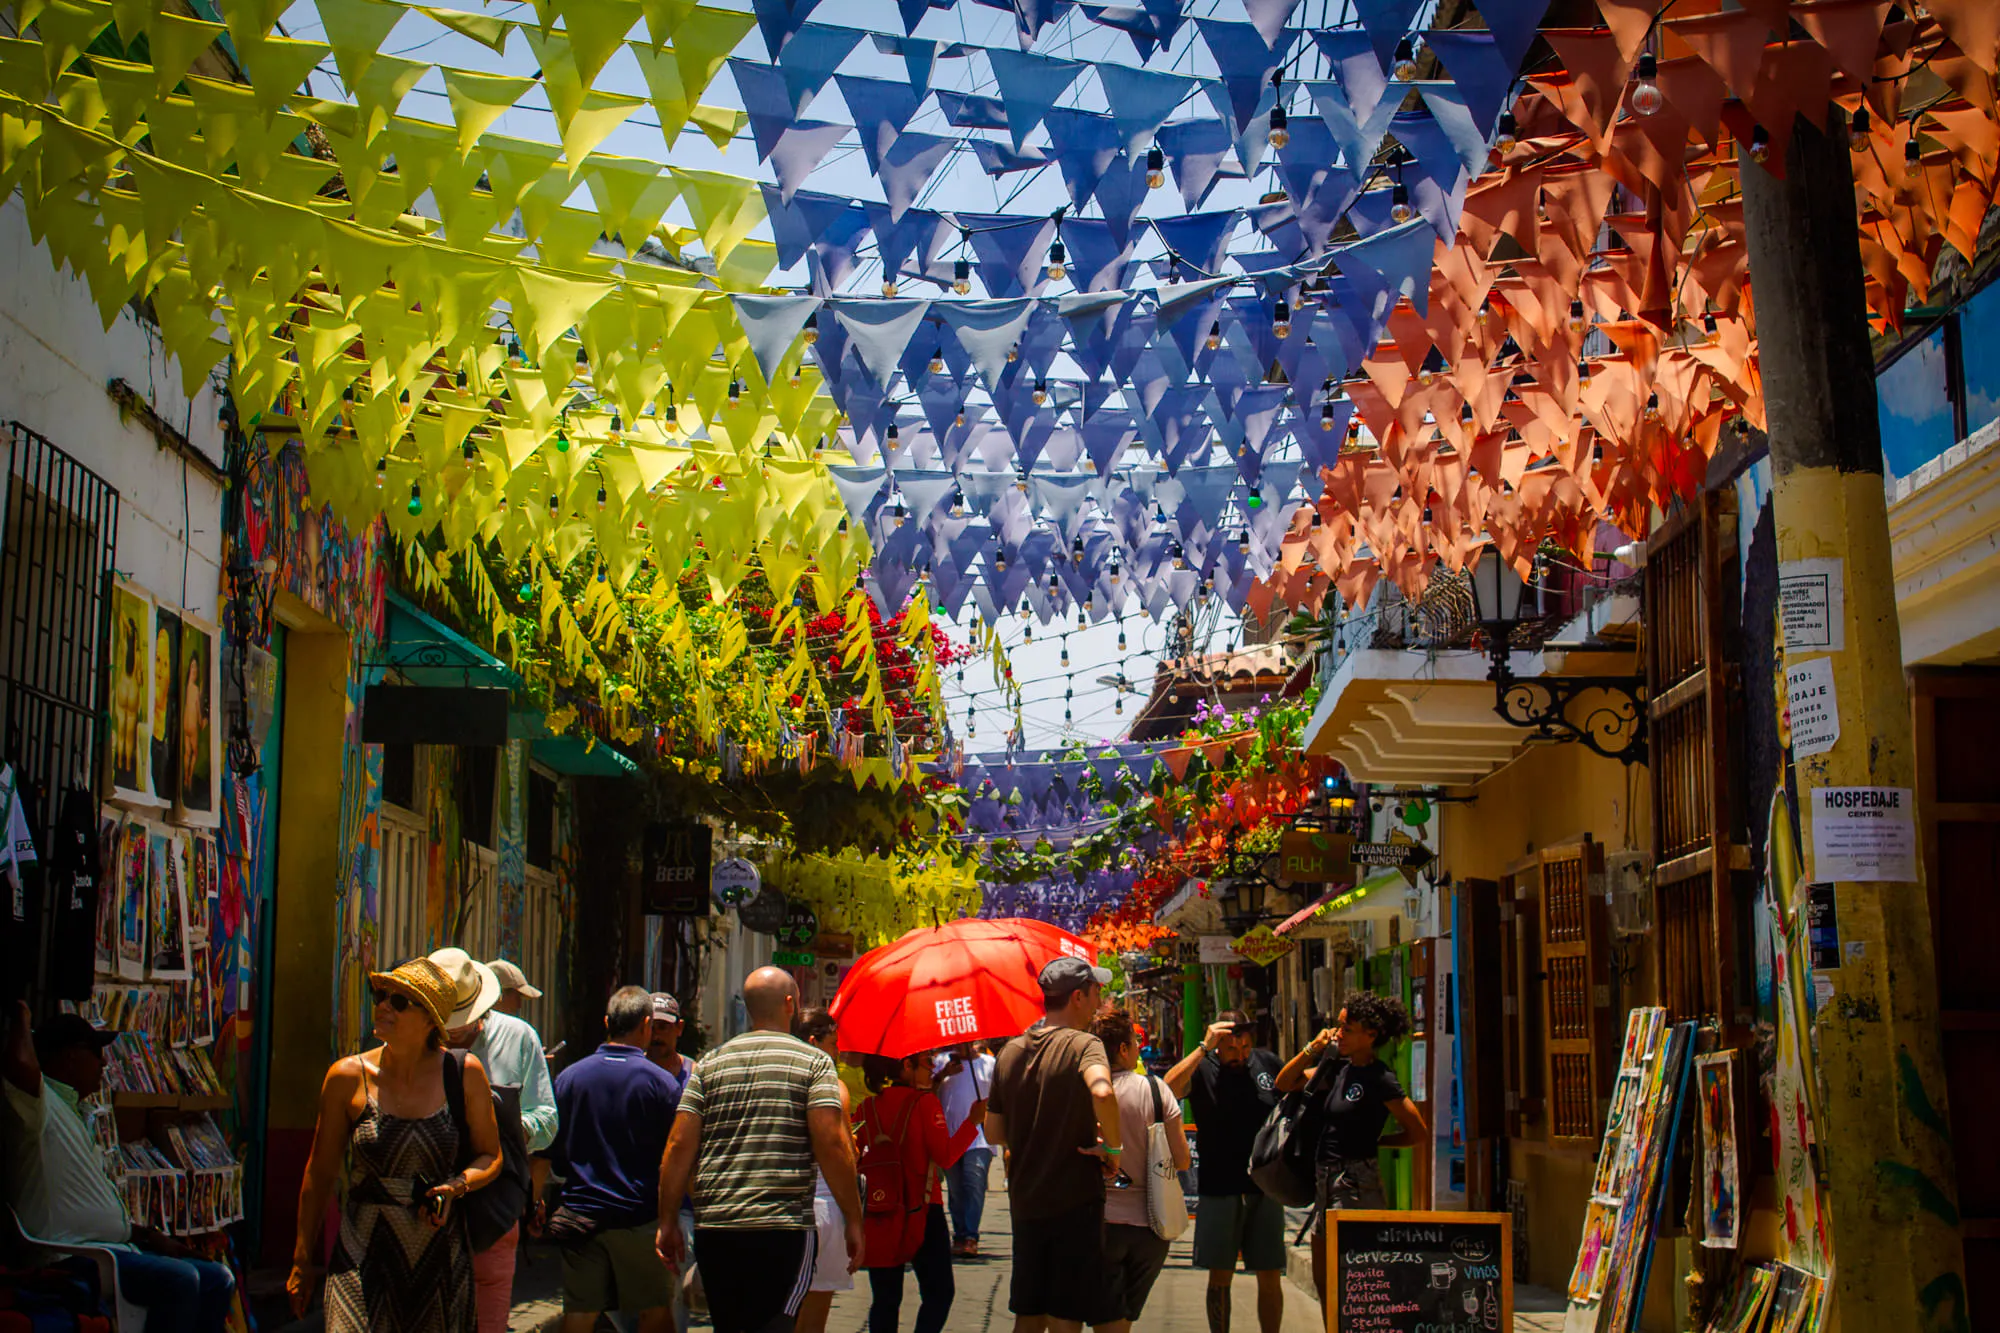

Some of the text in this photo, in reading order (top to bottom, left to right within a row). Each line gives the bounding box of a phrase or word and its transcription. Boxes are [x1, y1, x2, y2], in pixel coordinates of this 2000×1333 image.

[1788, 672, 1812, 686] TRO:
[1790, 685, 1827, 703] EDAJE
[1825, 791, 1900, 808] HOSPEDAJE
[1847, 810, 1884, 818] CENTRO
[1360, 854, 1404, 866] LAUNDRY
[655, 865, 696, 883] BEER
[786, 915, 815, 924] URA
[935, 996, 973, 1019] FREE
[937, 1014, 978, 1036] TOUR
[1345, 1250, 1424, 1264] Cervezas
[1345, 1290, 1391, 1304] Andina
